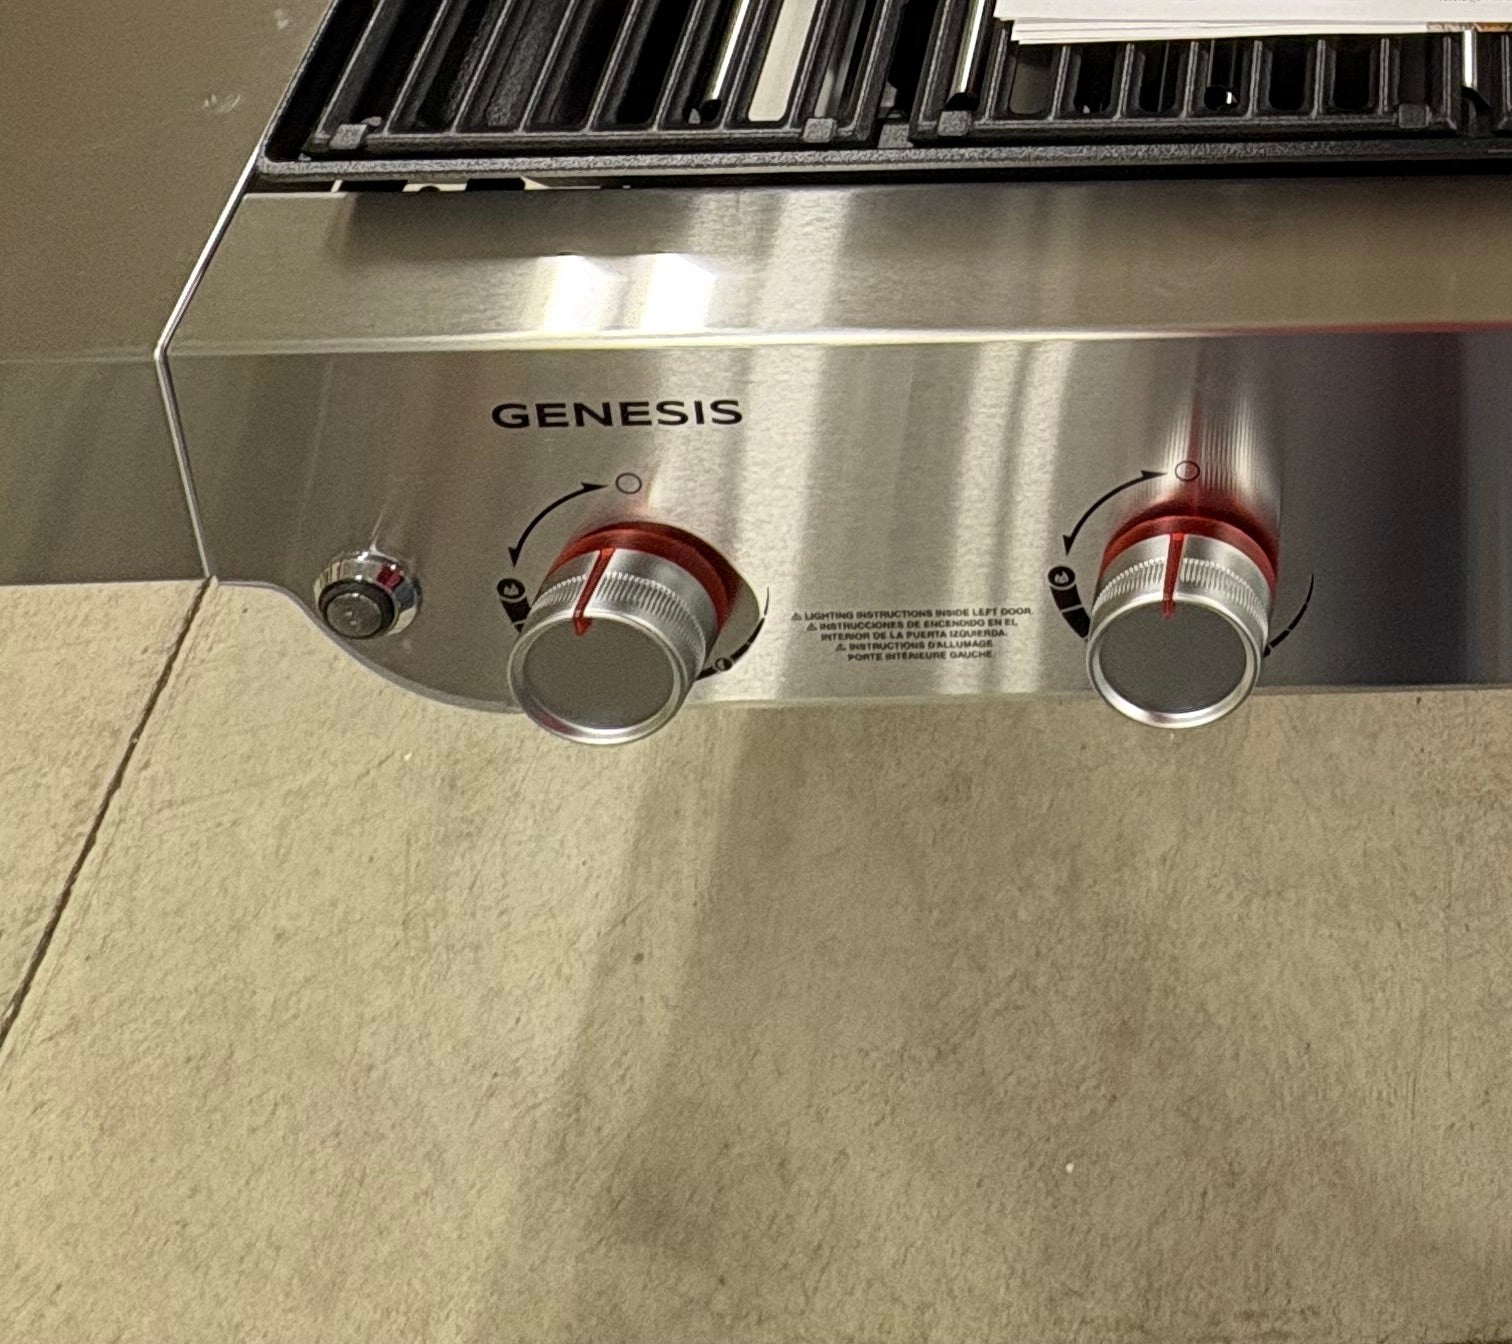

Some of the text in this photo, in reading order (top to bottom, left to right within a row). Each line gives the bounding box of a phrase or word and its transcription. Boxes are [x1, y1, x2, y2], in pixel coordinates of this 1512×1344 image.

[491, 400, 743, 429] GENESIS
[804, 611, 854, 621] LIGHTING
[856, 610, 933, 619] INSTRUCTIONS
[935, 609, 970, 618] INSIDE
[972, 608, 998, 617] LEFT
[819, 618, 1018, 631] INSTRUCCIONES DE ENCENDIDO EN EL
[820, 632, 870, 641] INTERIOR
[872, 631, 886, 640] DE
[889, 631, 904, 640] LA
[906, 630, 947, 639] PUERTA
[849, 641, 925, 651] INSTRUCTIONS
[847, 653, 882, 661] PORTE
[949, 650, 992, 659] GAUCHE
